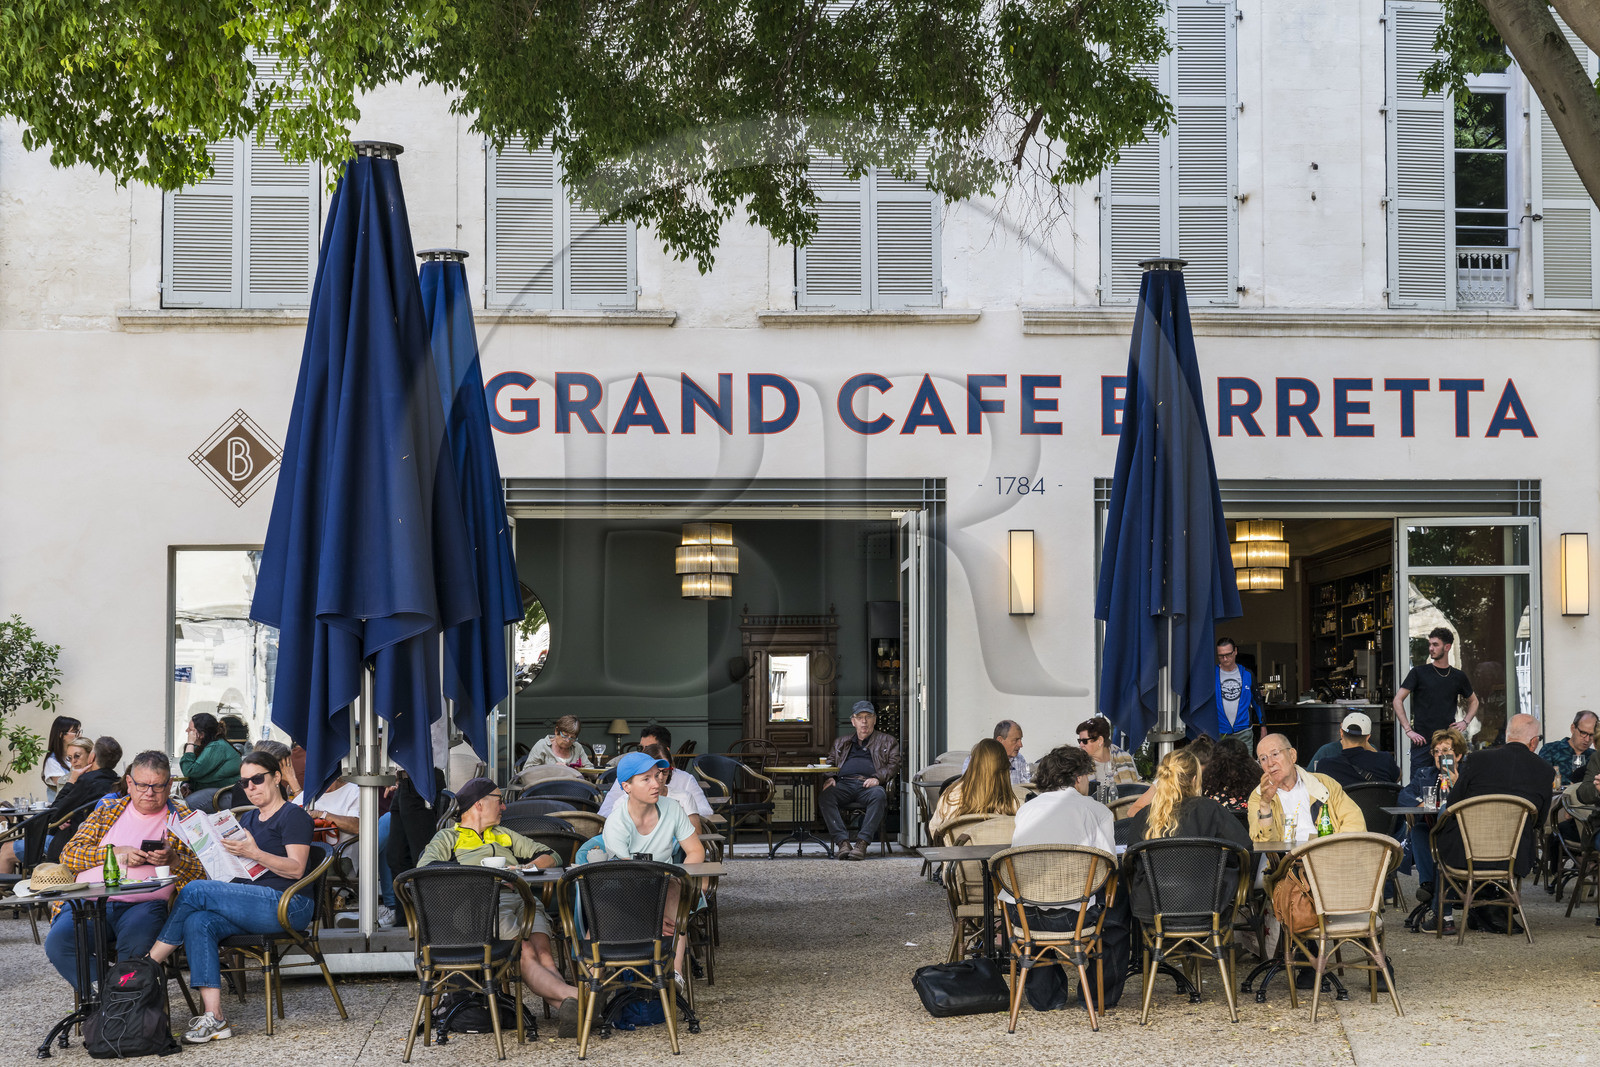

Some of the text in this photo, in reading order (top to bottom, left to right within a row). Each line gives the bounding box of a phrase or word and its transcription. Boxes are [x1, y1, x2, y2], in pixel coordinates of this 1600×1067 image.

[484, 371, 1539, 439] GRAND CAFE BRRETTA
[226, 436, 254, 481] B
[995, 476, 1046, 496] 1784
